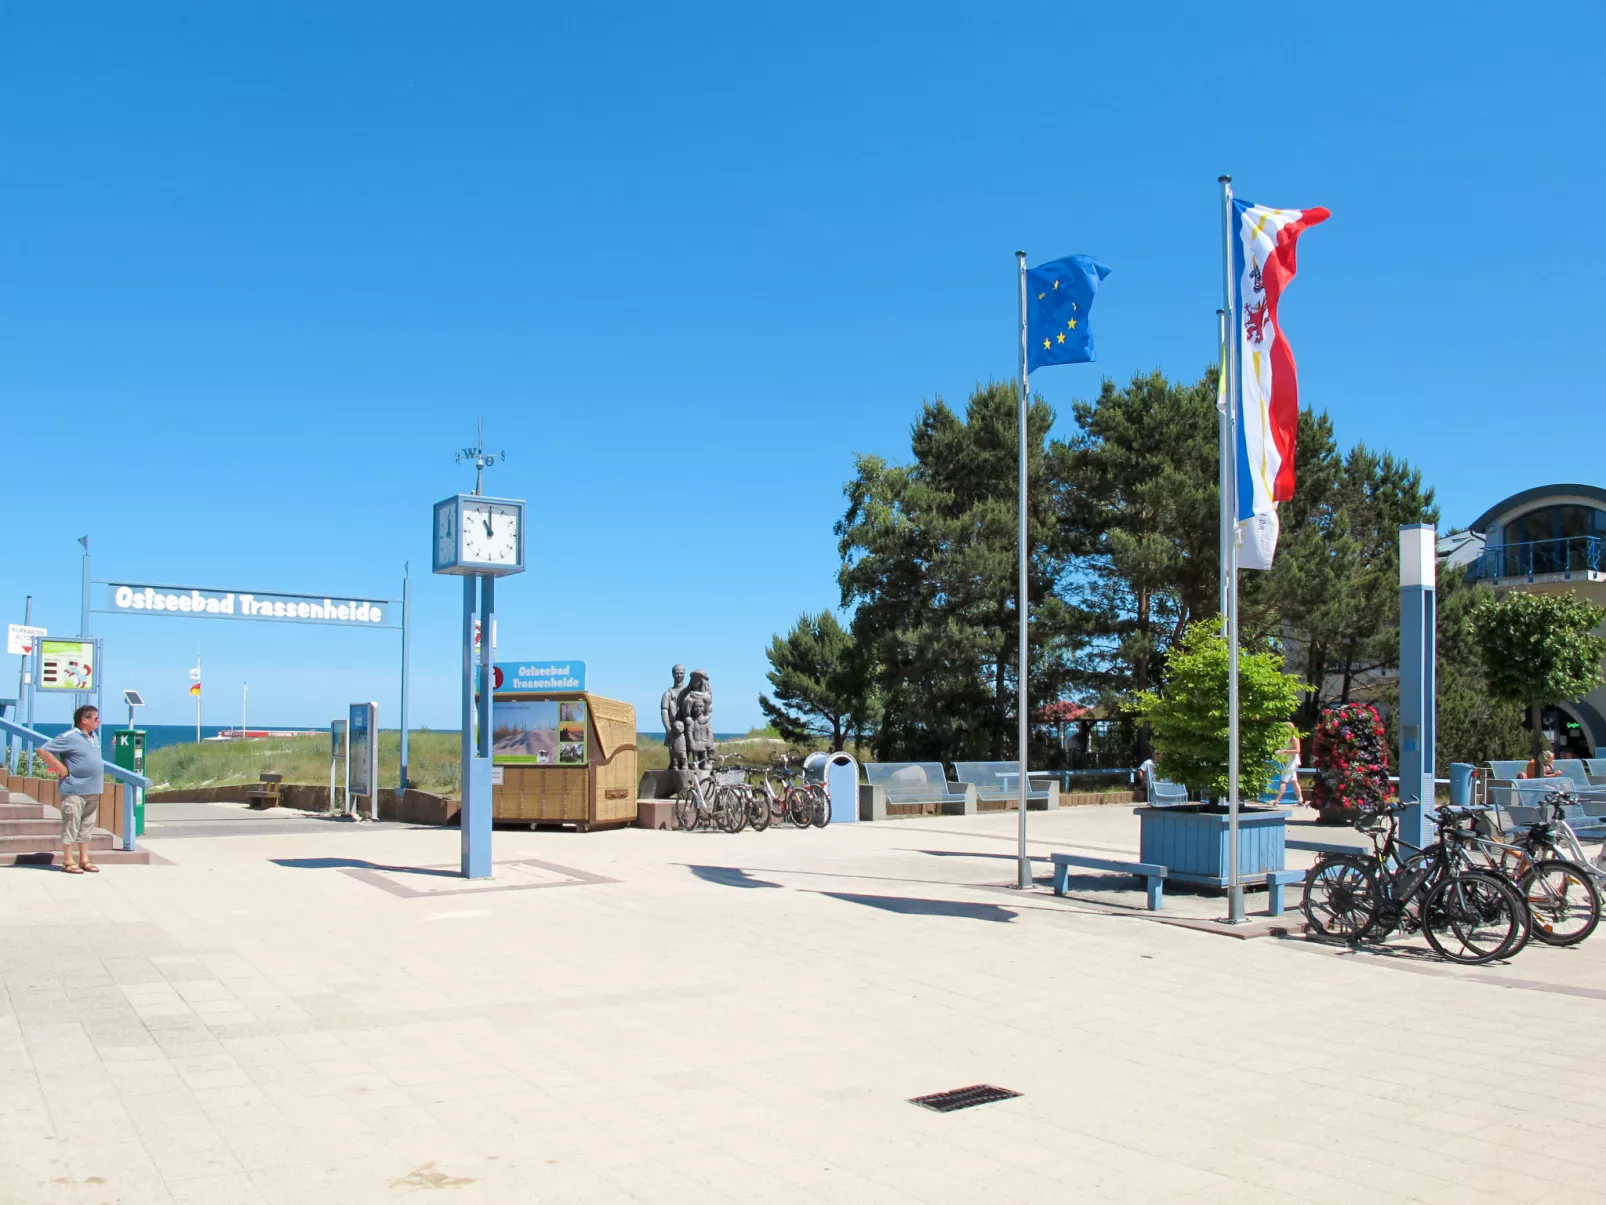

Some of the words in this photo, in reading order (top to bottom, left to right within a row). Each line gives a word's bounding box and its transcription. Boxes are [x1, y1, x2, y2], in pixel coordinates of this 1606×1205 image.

[461, 448, 477, 459] W
[115, 586, 235, 614] Ostseebad
[239, 594, 382, 622] Trassenheide
[518, 665, 570, 677] Ostseebad
[512, 677, 579, 689] Trassenheide
[120, 735, 129, 746] K
